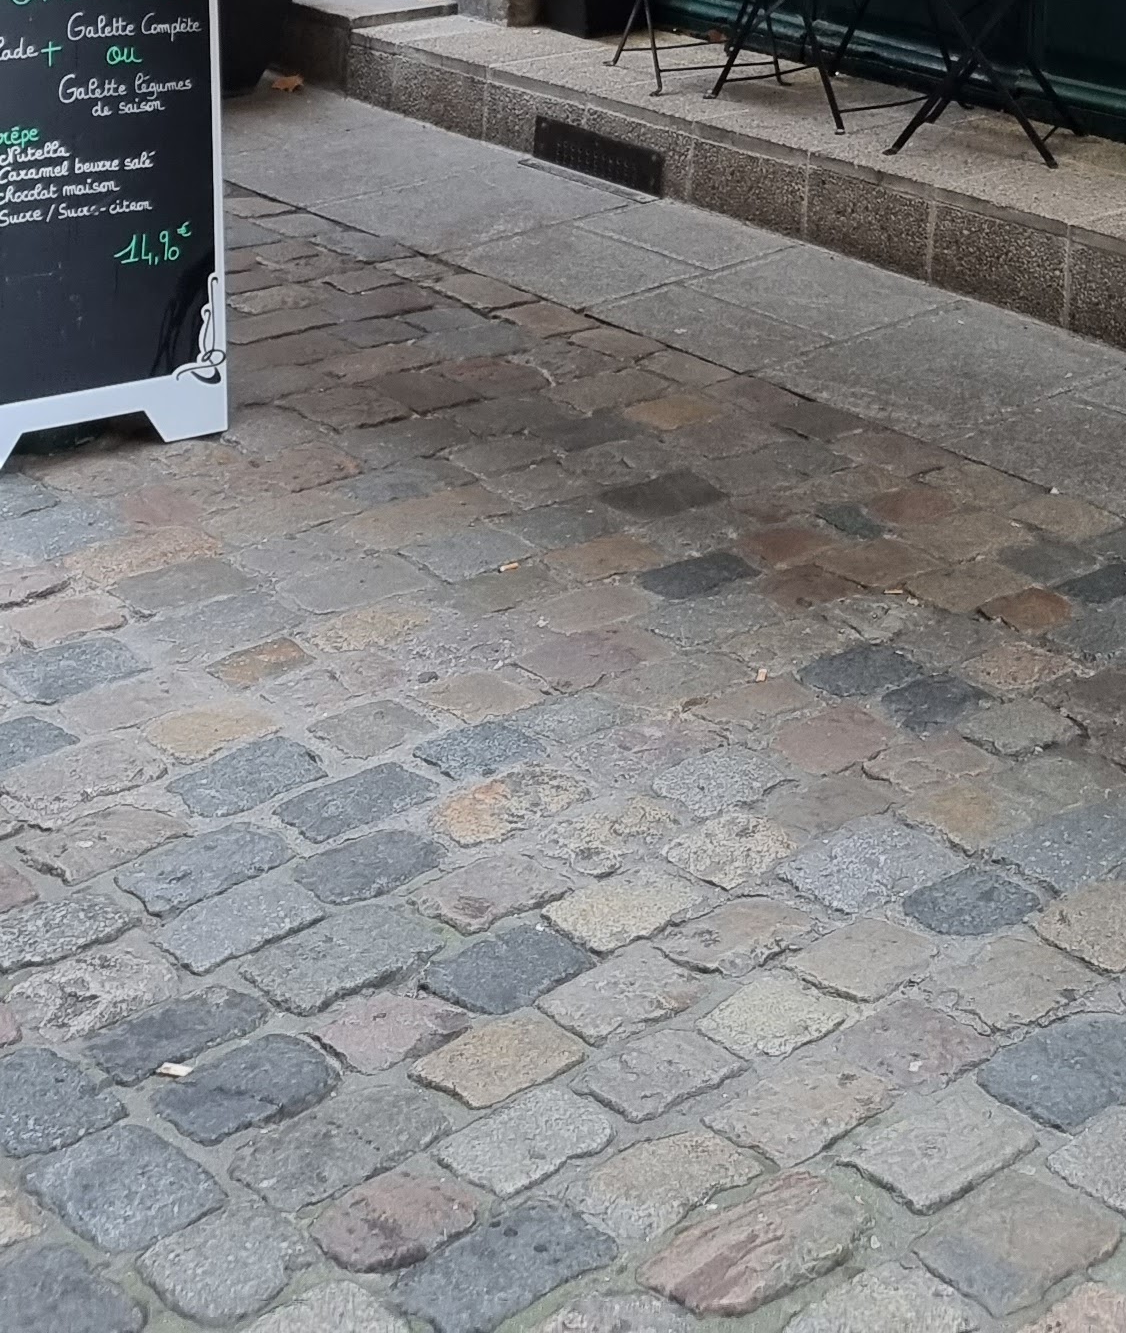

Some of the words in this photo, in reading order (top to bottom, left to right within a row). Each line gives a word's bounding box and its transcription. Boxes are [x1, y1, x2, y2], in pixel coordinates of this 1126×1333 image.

[67, 12, 135, 41] Galette
[58, 74, 127, 104] Galette
[134, 72, 192, 100] légumes
[92, 101, 112, 116] de
[118, 98, 165, 114] saison
[74, 157, 120, 174] beurre
[124, 151, 156, 170] salé
[62, 178, 121, 197] maison
[0, 209, 43, 227] Sucre
